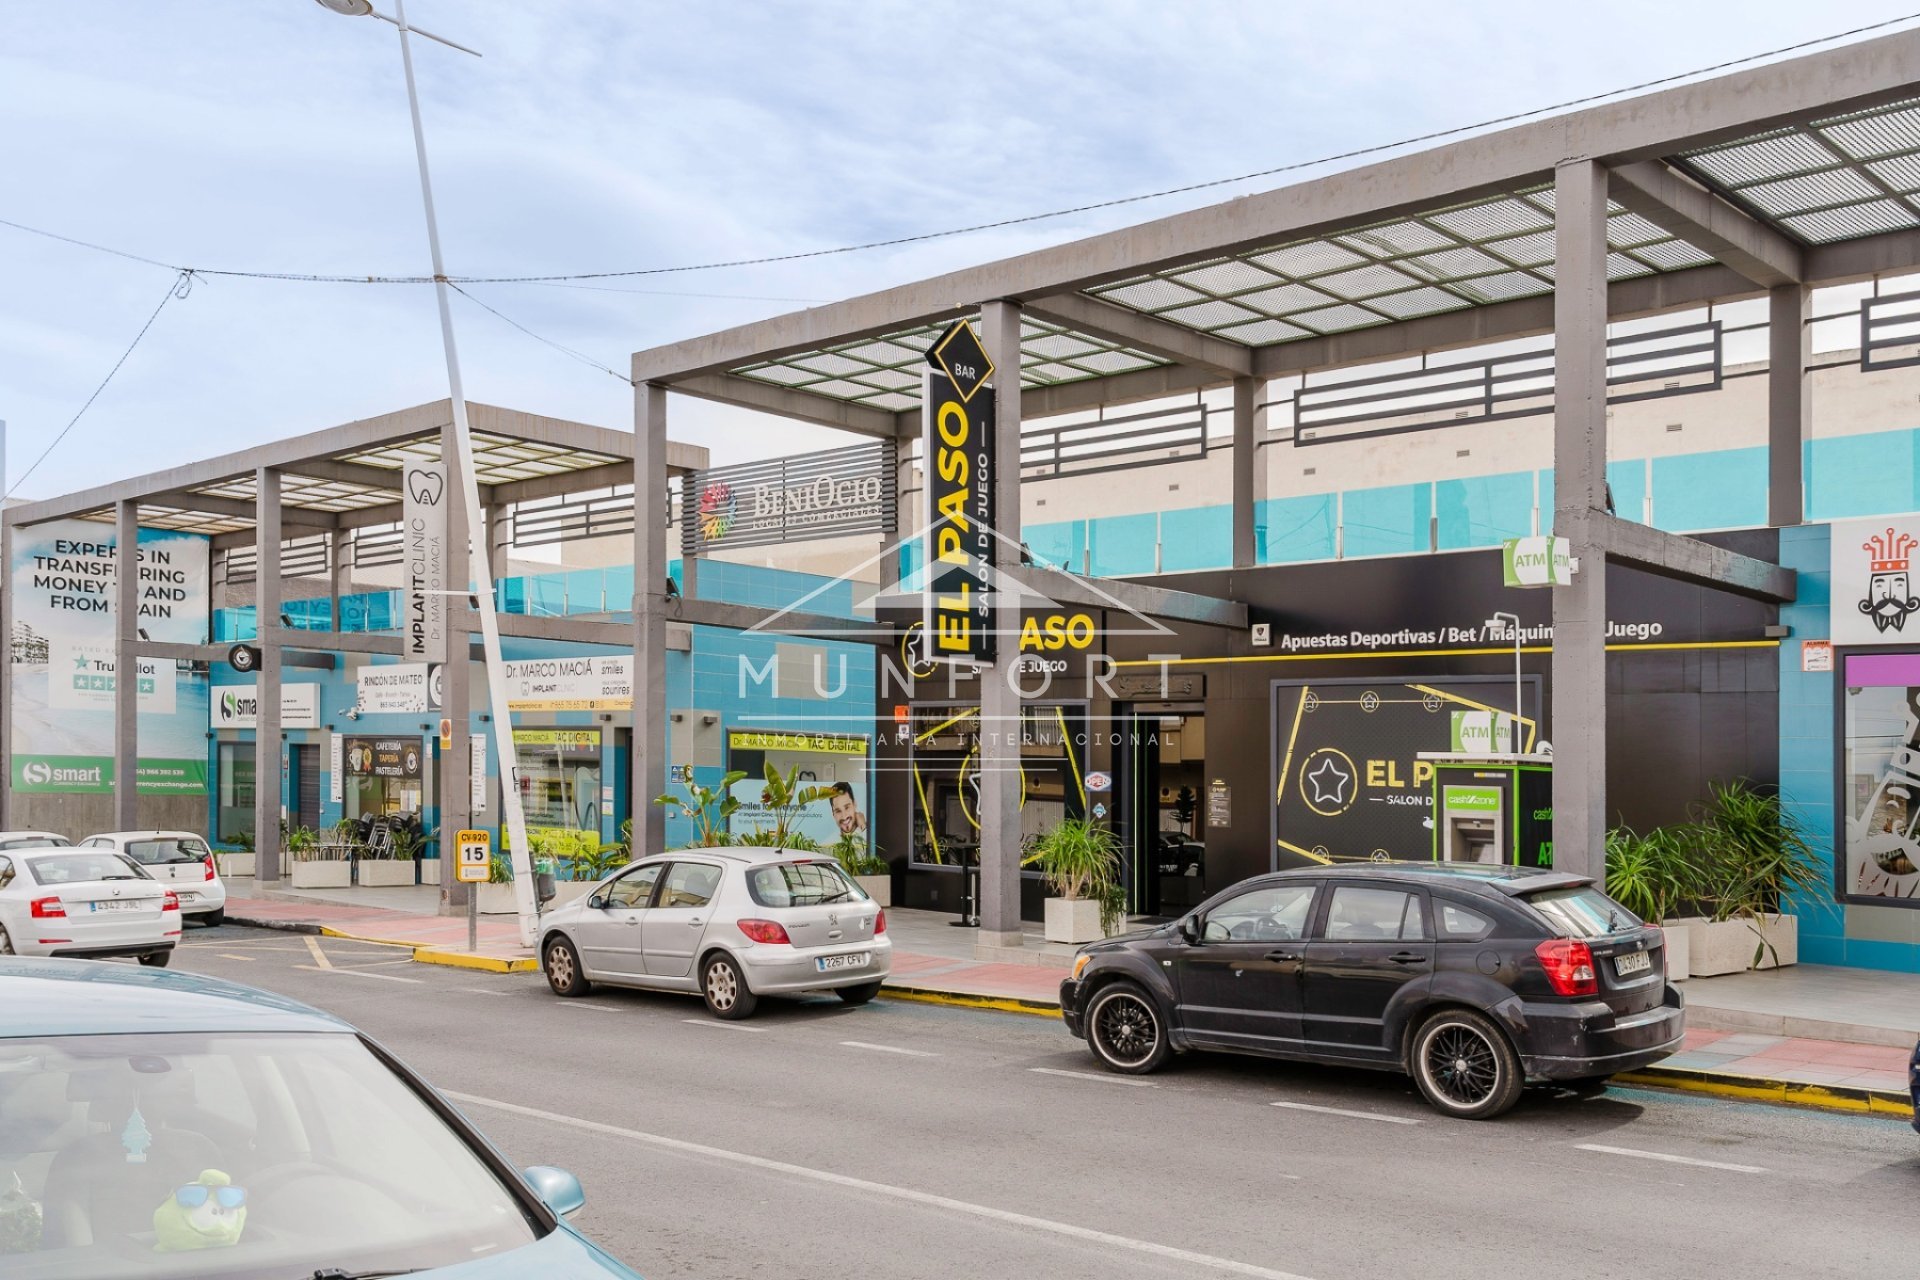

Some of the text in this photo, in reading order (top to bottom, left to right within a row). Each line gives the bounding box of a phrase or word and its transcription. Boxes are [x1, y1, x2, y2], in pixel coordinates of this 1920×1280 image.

[954, 363, 976, 380] BAR
[937, 401, 970, 652] EL PASO
[977, 452, 989, 618] SALON DE JUEGO
[55, 539, 171, 565] EXPERS IN
[1515, 553, 1546, 568] ATM
[1553, 554, 1570, 568] ATM
[33, 556, 185, 584] TRANSFRING
[33, 574, 107, 595] MONEY
[144, 586, 186, 601] AND
[50, 595, 109, 613] FROM
[1020, 614, 1095, 652] ASO
[1281, 632, 1348, 651] Apuestas
[1350, 628, 1436, 650] Deportivas
[1448, 626, 1477, 643] Bet
[1489, 623, 1554, 644] Máquin
[1604, 620, 1663, 642] Juego
[94, 660, 156, 675] Truilot
[506, 658, 593, 678] Dr. MARCO MACIÁ
[601, 664, 624, 675] smiles
[1020, 660, 1068, 673] E JUEGO
[364, 673, 423, 687] RINCÓN DE MATEO
[237, 698, 257, 716] sma
[1461, 726, 1489, 738] ATM
[375, 740, 402, 751] CAFETERÍA
[807, 739, 826, 750] TAC
[828, 740, 862, 752] DIGITAL
[53, 766, 101, 782] smart
[375, 765, 404, 776] PASTELERÍA
[1366, 760, 1405, 788] EL
[1386, 795, 1433, 807] SALON D
[461, 833, 488, 842] CV-920
[464, 846, 484, 862] 15
[1537, 842, 1553, 865] AT
[826, 956, 845, 968] 2267
